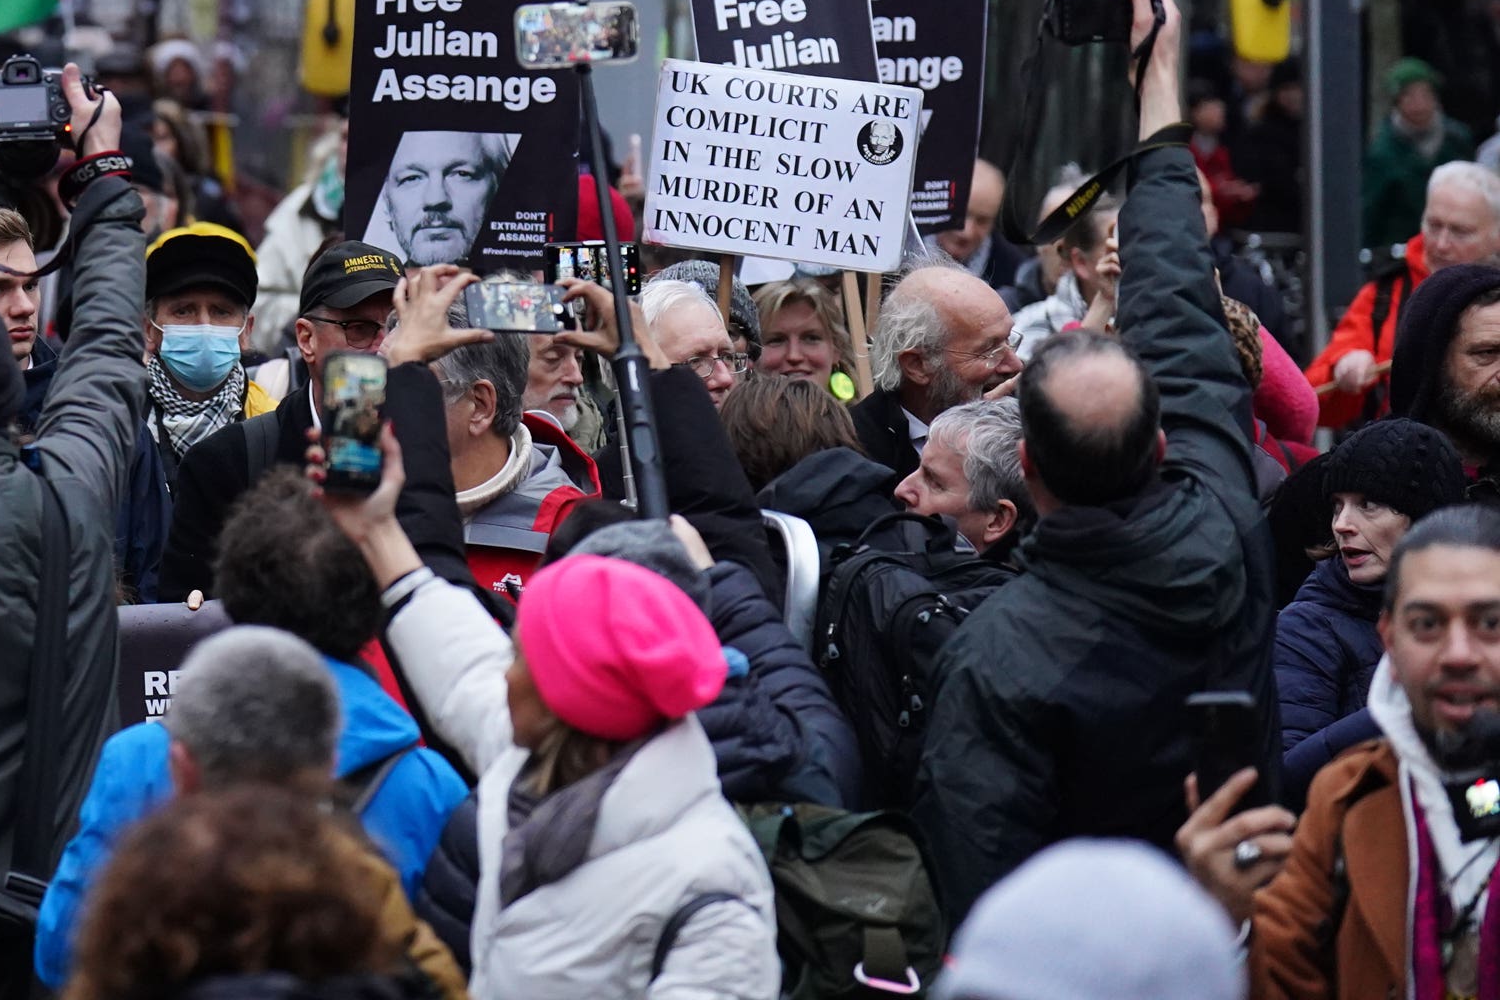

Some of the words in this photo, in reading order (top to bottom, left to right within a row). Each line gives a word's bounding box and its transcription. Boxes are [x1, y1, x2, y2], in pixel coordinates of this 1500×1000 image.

[374, 20, 498, 58] Julian
[722, 31, 840, 69] Julian
[372, 68, 556, 111] Assange
[878, 56, 963, 90] ange
[671, 71, 711, 96] UK
[725, 76, 838, 111] COURTS
[852, 92, 910, 120] ARE
[666, 105, 828, 144] COMPLICIT
[661, 139, 691, 163] IN
[706, 144, 762, 171] THE
[775, 153, 861, 183] SLOW
[515, 211, 547, 221] DON'T
[657, 174, 779, 209] MURDER
[794, 190, 834, 215] OF
[844, 199, 884, 222] AN
[1066, 182, 1100, 218] Nikon
[490, 221, 547, 232] EXTRADITE
[498, 232, 546, 243] ASSANGE
[653, 208, 801, 247] INNOCENT
[813, 229, 881, 257] MAN
[344, 254, 385, 269] AMNESTY
